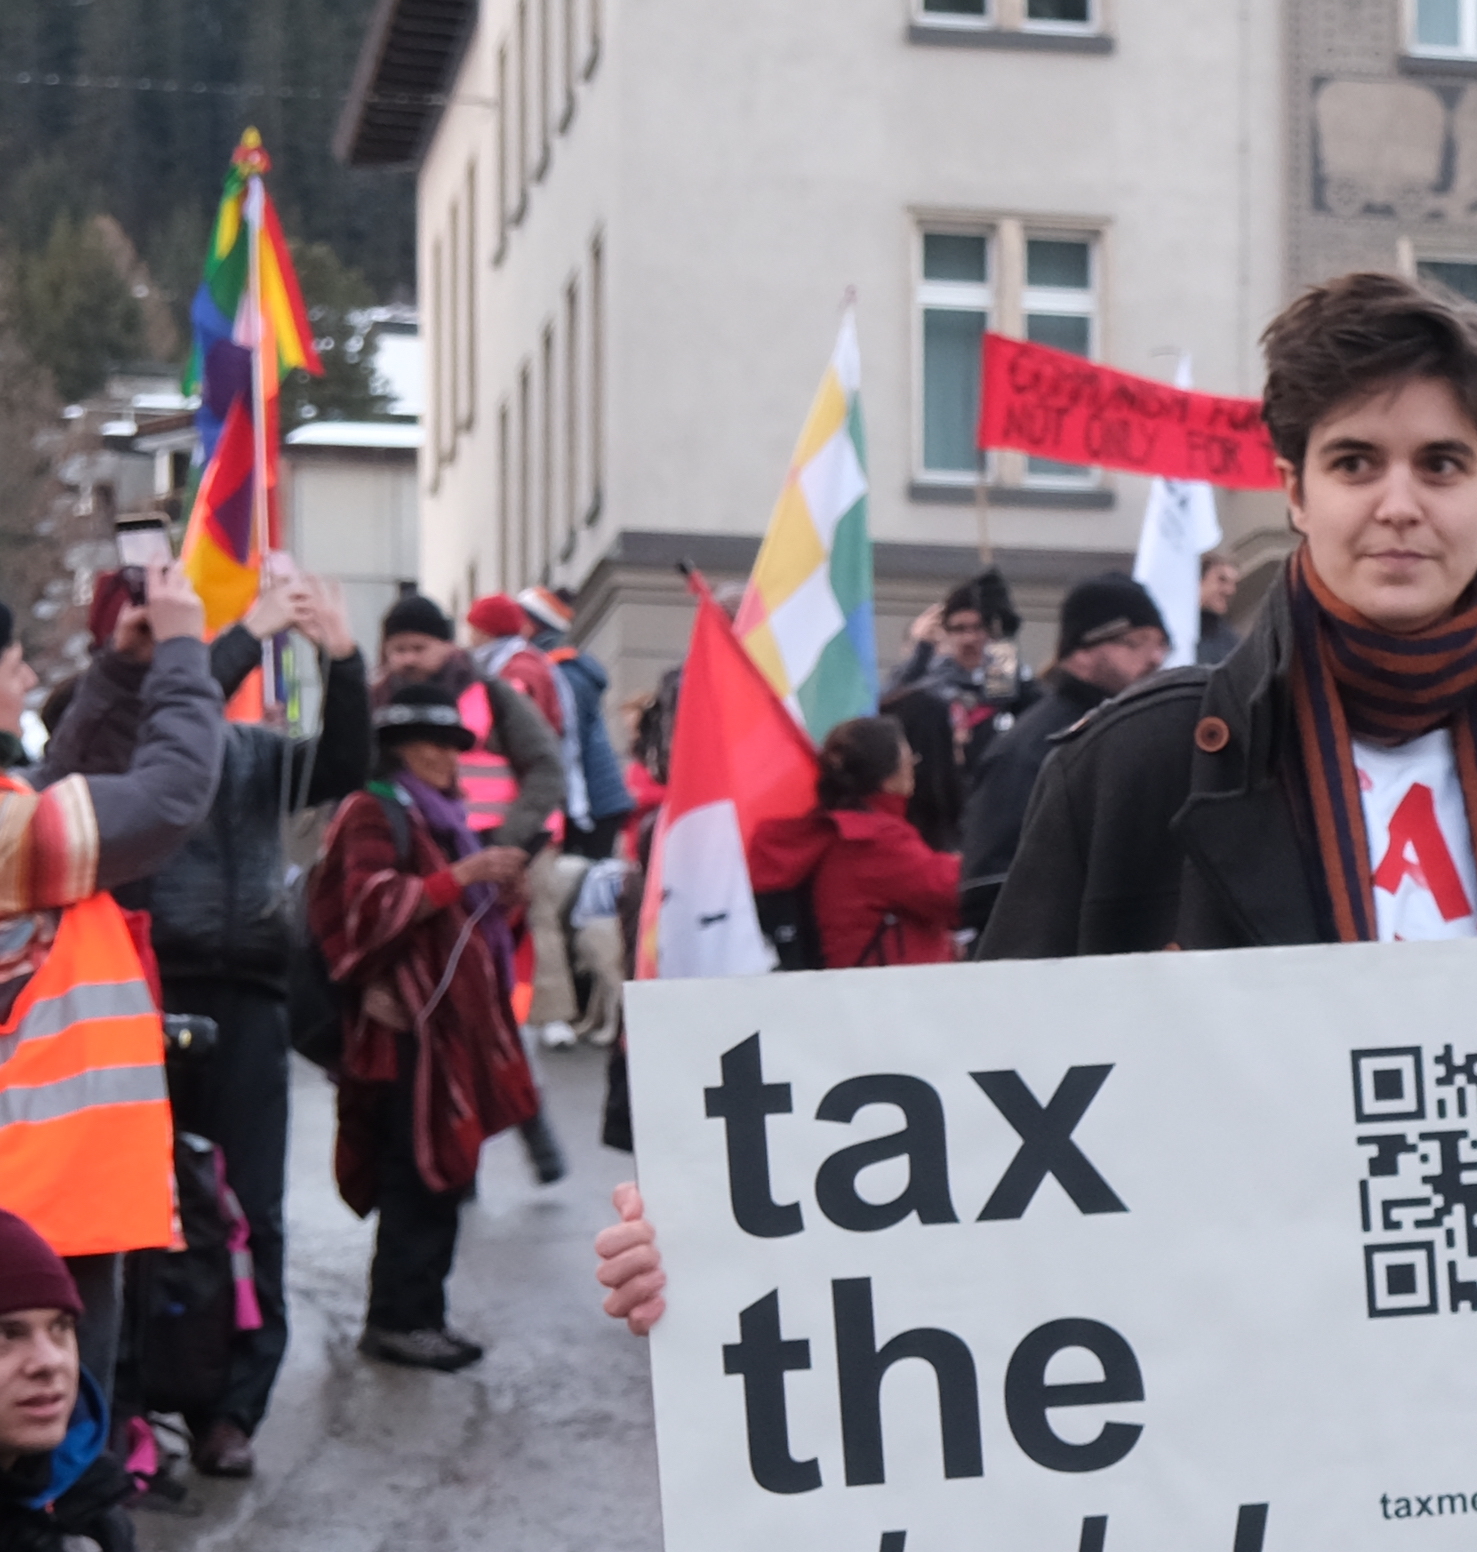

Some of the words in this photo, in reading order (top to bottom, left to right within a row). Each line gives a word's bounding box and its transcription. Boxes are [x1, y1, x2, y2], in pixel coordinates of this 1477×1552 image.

[1003, 404, 1070, 447] NOT
[1084, 412, 1160, 465] ONLY
[1186, 429, 1242, 475] FOR
[704, 1031, 1130, 1240] tax
[722, 1276, 1146, 1495] the
